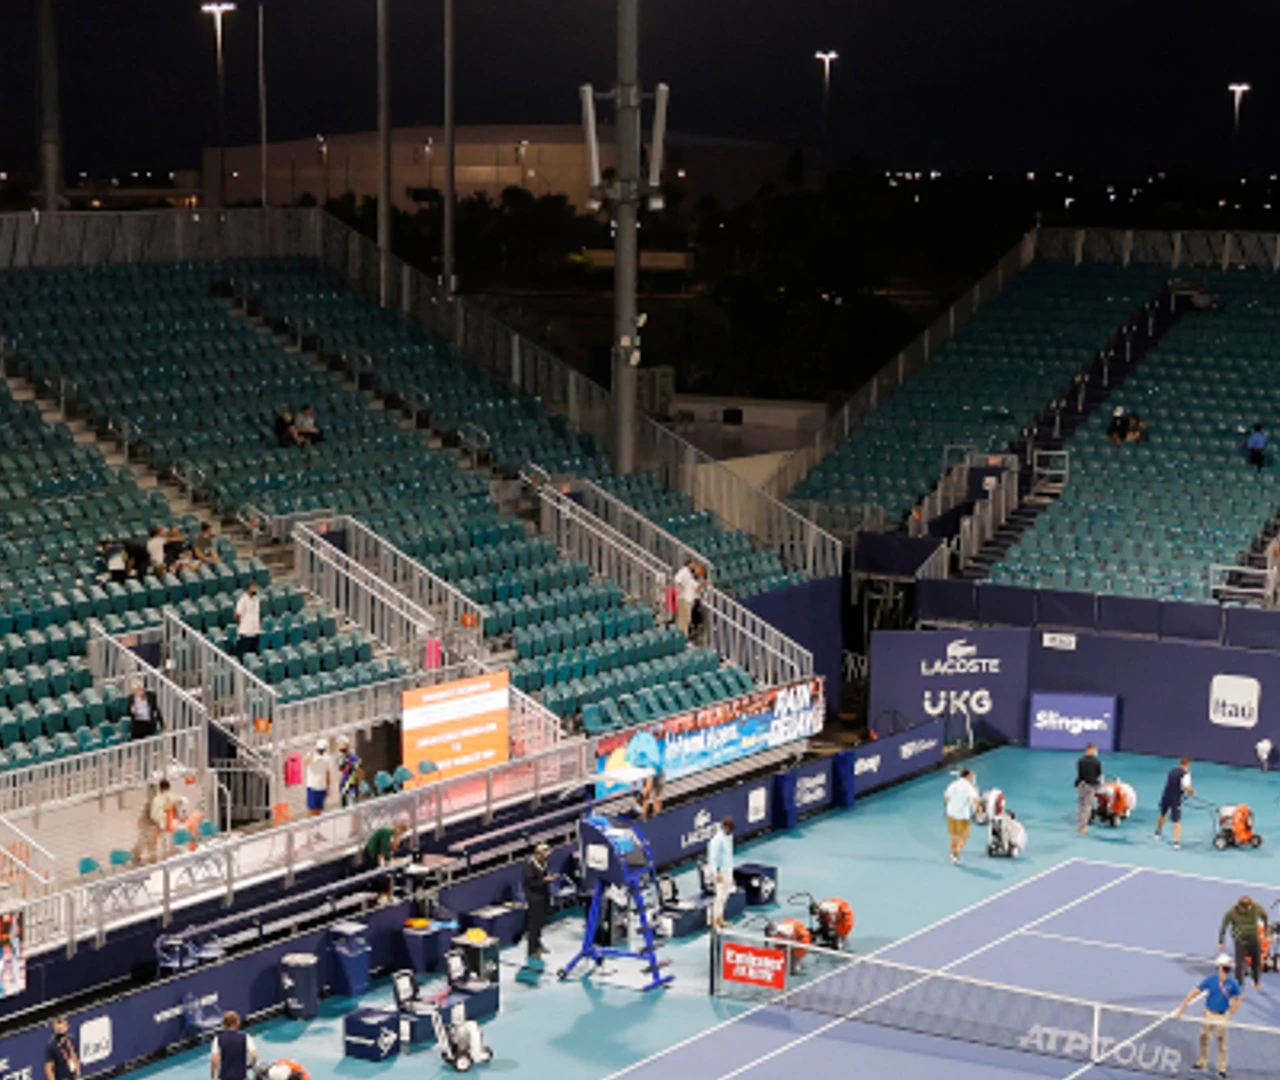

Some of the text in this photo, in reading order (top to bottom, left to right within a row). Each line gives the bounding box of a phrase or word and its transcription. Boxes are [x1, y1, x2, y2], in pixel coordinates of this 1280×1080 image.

[921, 657, 1002, 676] LACOSTE
[923, 689, 993, 716] UKG
[1211, 697, 1256, 721] Itaú
[1035, 709, 1107, 734] Slinger
